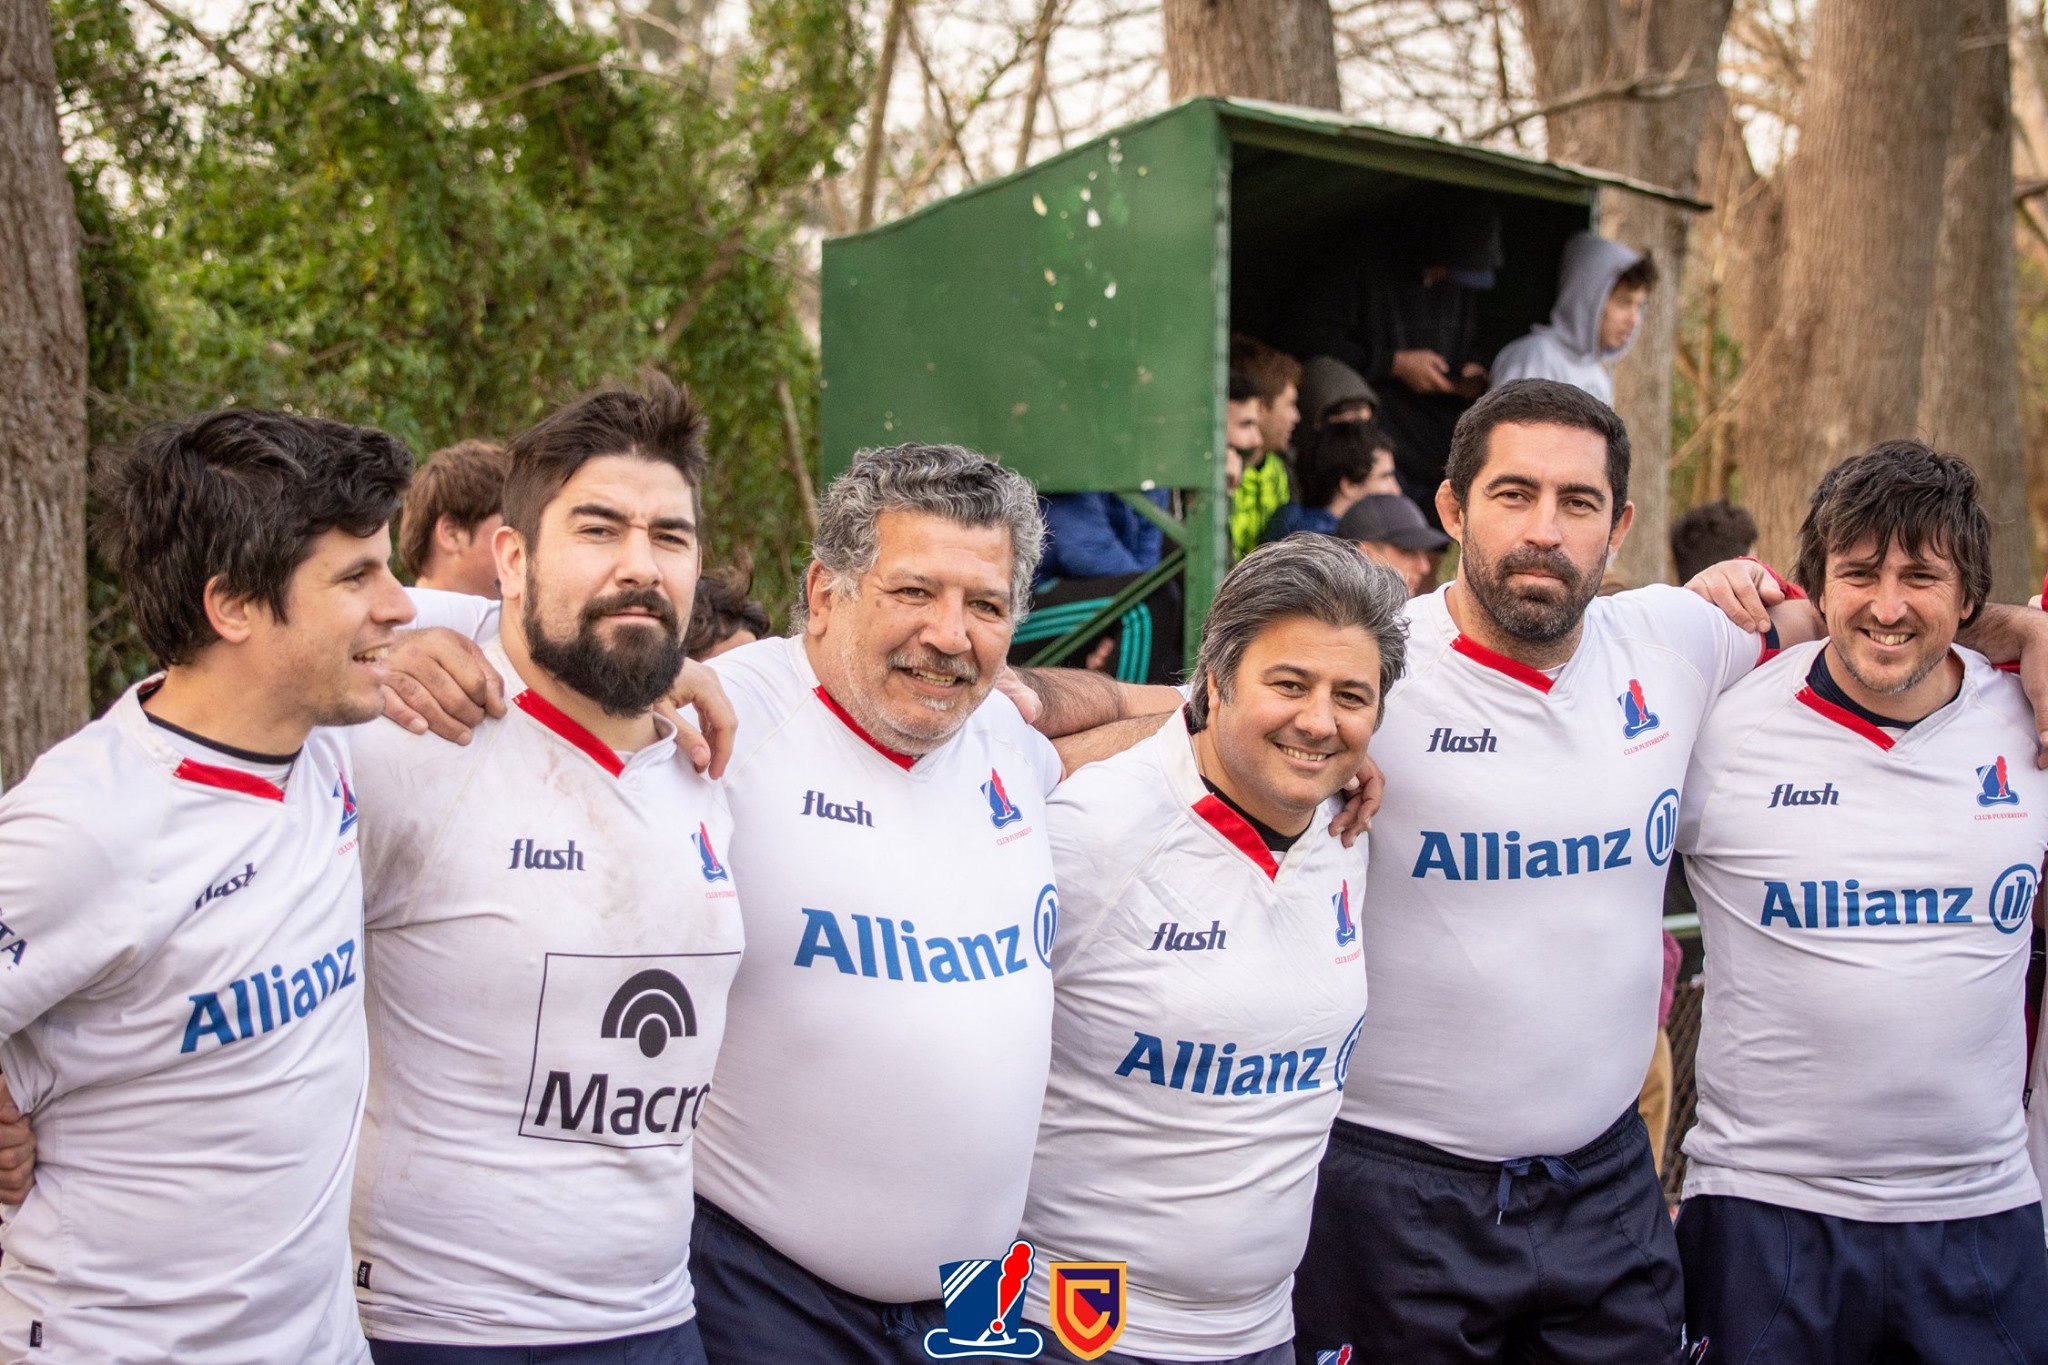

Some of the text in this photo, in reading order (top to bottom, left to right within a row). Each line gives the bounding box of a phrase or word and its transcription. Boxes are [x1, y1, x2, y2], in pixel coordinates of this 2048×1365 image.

[1425, 727, 1498, 753] flash
[799, 789, 876, 829] flash
[1767, 782, 1840, 809] flash
[507, 838, 586, 871] flash
[1411, 827, 1632, 882] Allianz
[1760, 878, 1974, 929] Allianz
[793, 907, 1029, 984] Allianz
[1147, 920, 1227, 952] flash
[180, 937, 357, 1054] Allianz
[1114, 1030, 1328, 1097] Allianz
